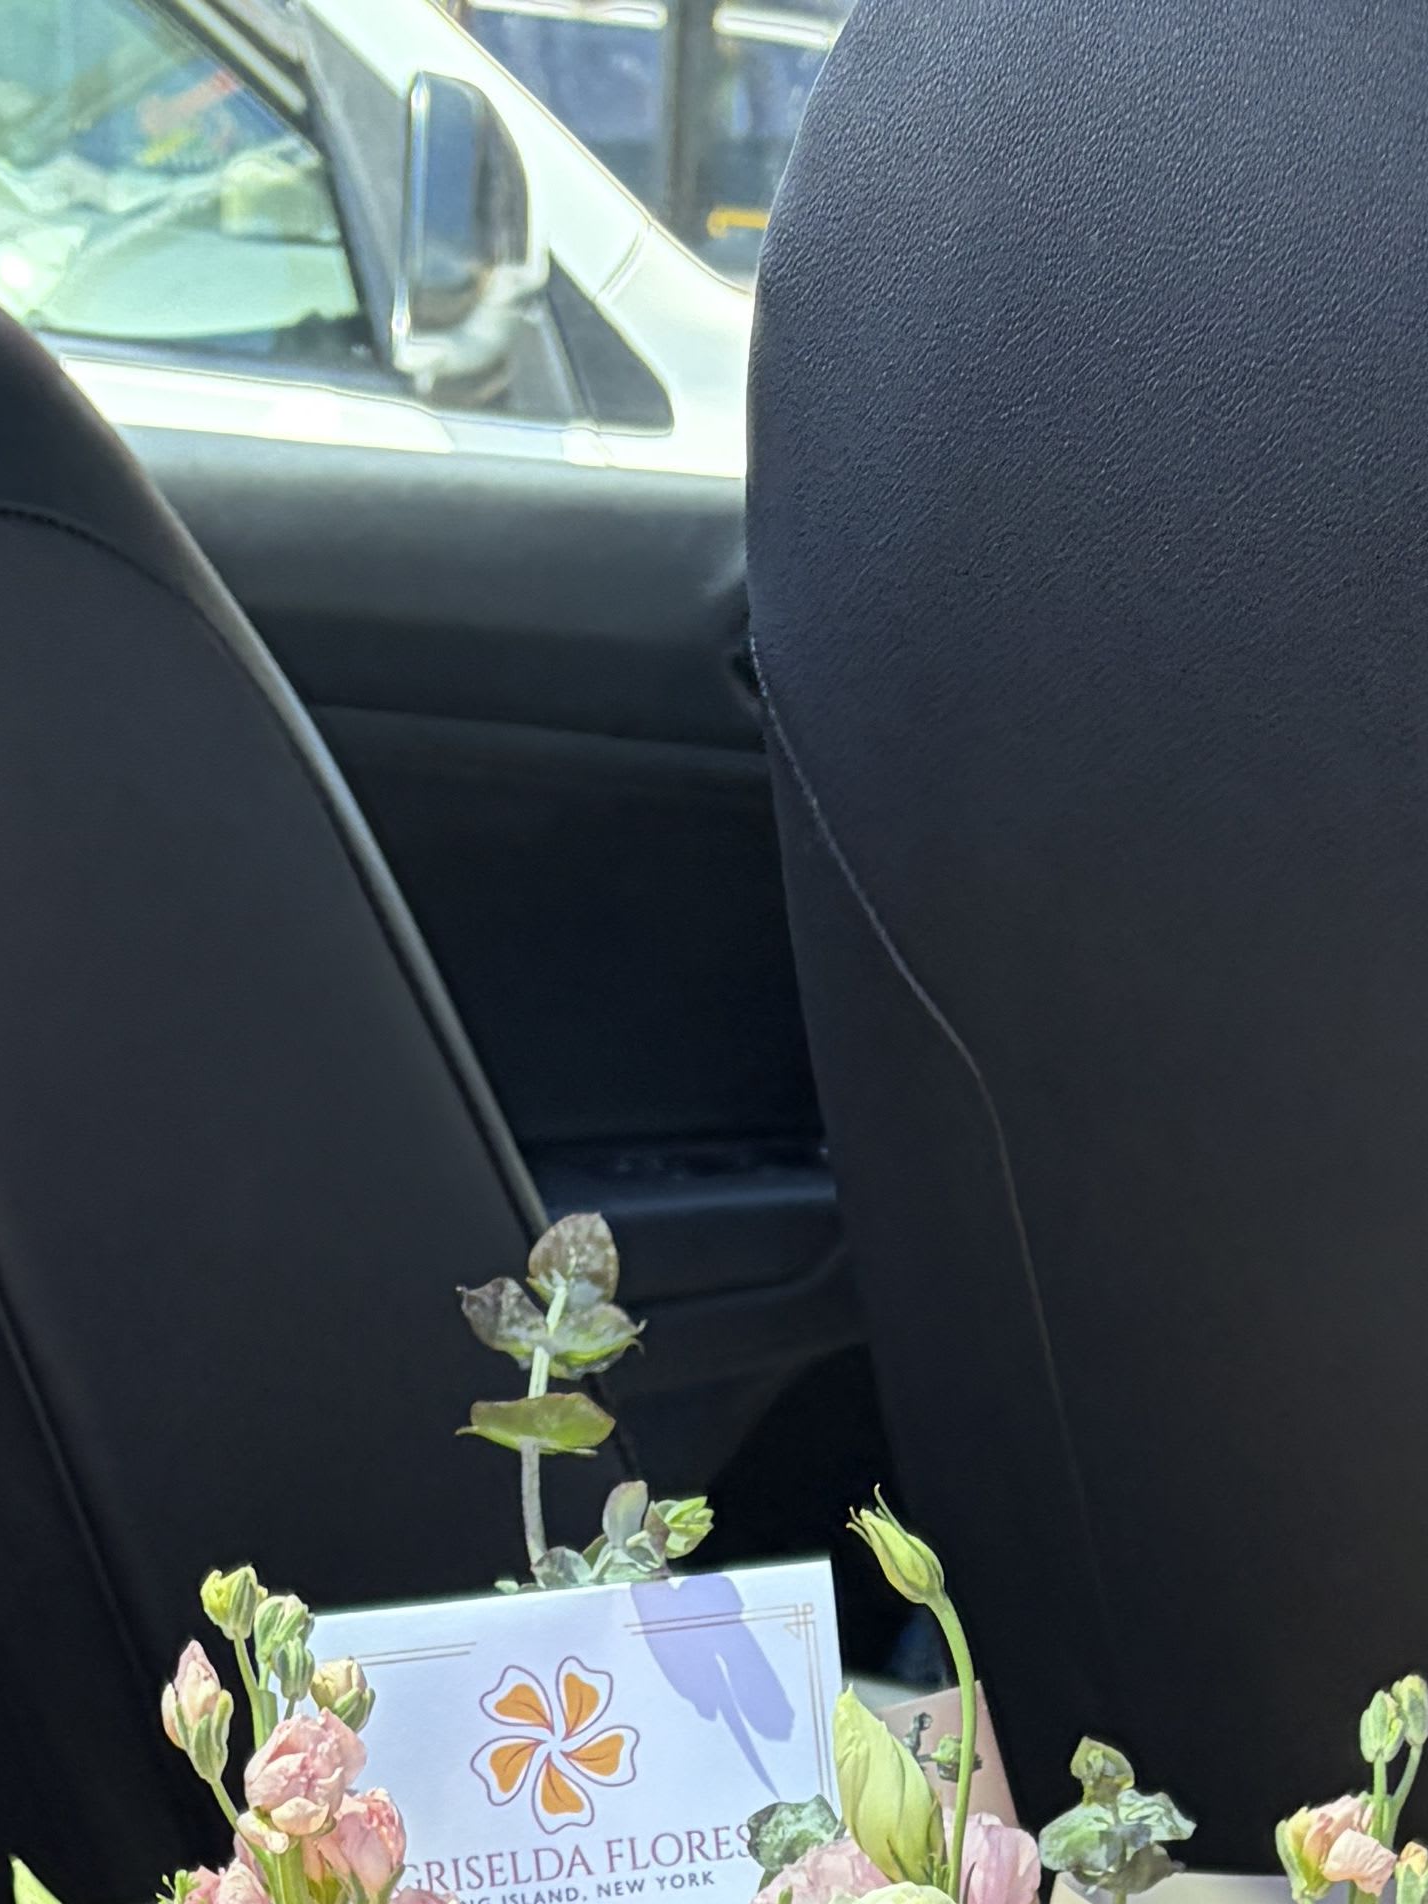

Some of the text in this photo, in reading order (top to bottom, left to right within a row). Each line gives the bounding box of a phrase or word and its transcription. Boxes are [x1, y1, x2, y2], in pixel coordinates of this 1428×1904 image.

[606, 1824, 751, 1873] FLORES
[597, 1879, 645, 1898] NEW
[656, 1871, 715, 1891] YORK
